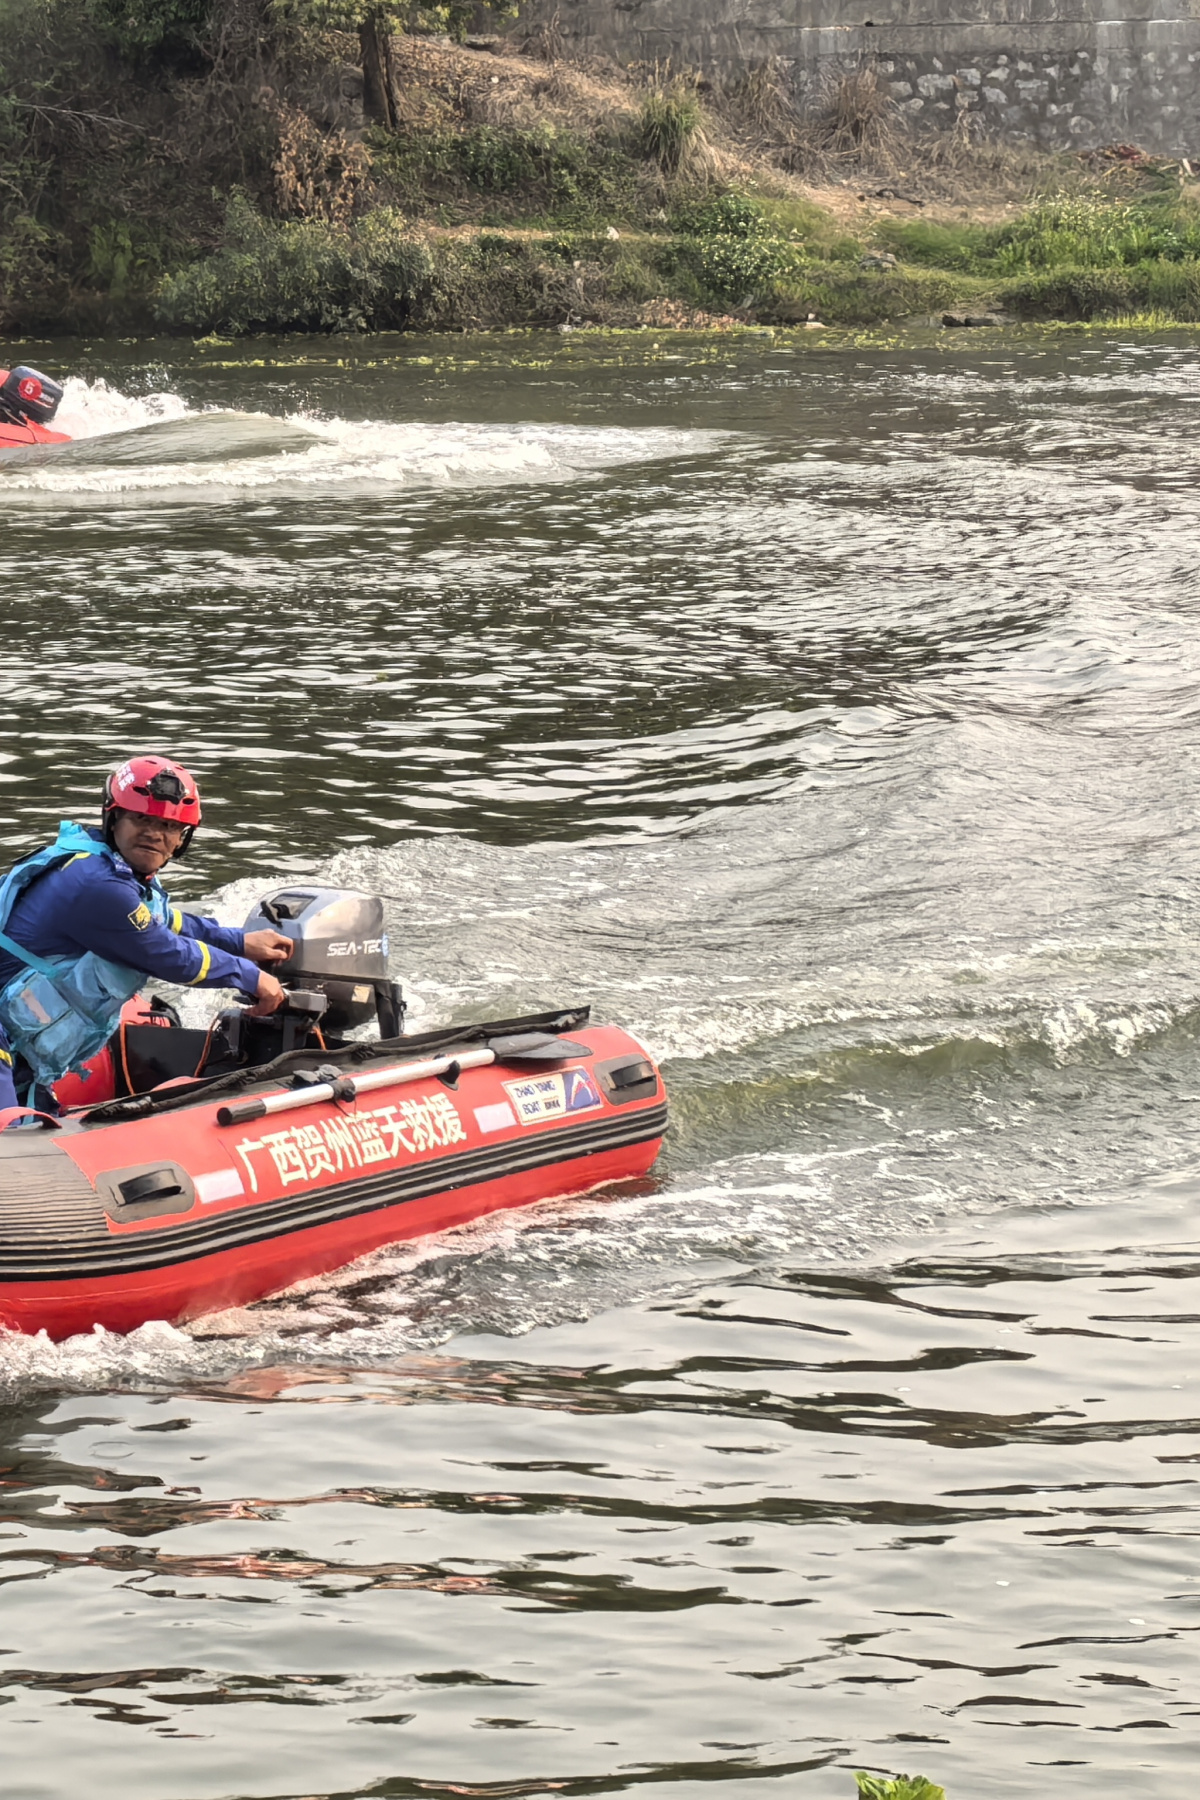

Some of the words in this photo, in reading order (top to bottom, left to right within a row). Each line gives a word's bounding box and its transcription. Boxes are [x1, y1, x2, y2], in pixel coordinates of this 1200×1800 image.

[235, 1092, 467, 1193] 广西贺州蓝天救援
